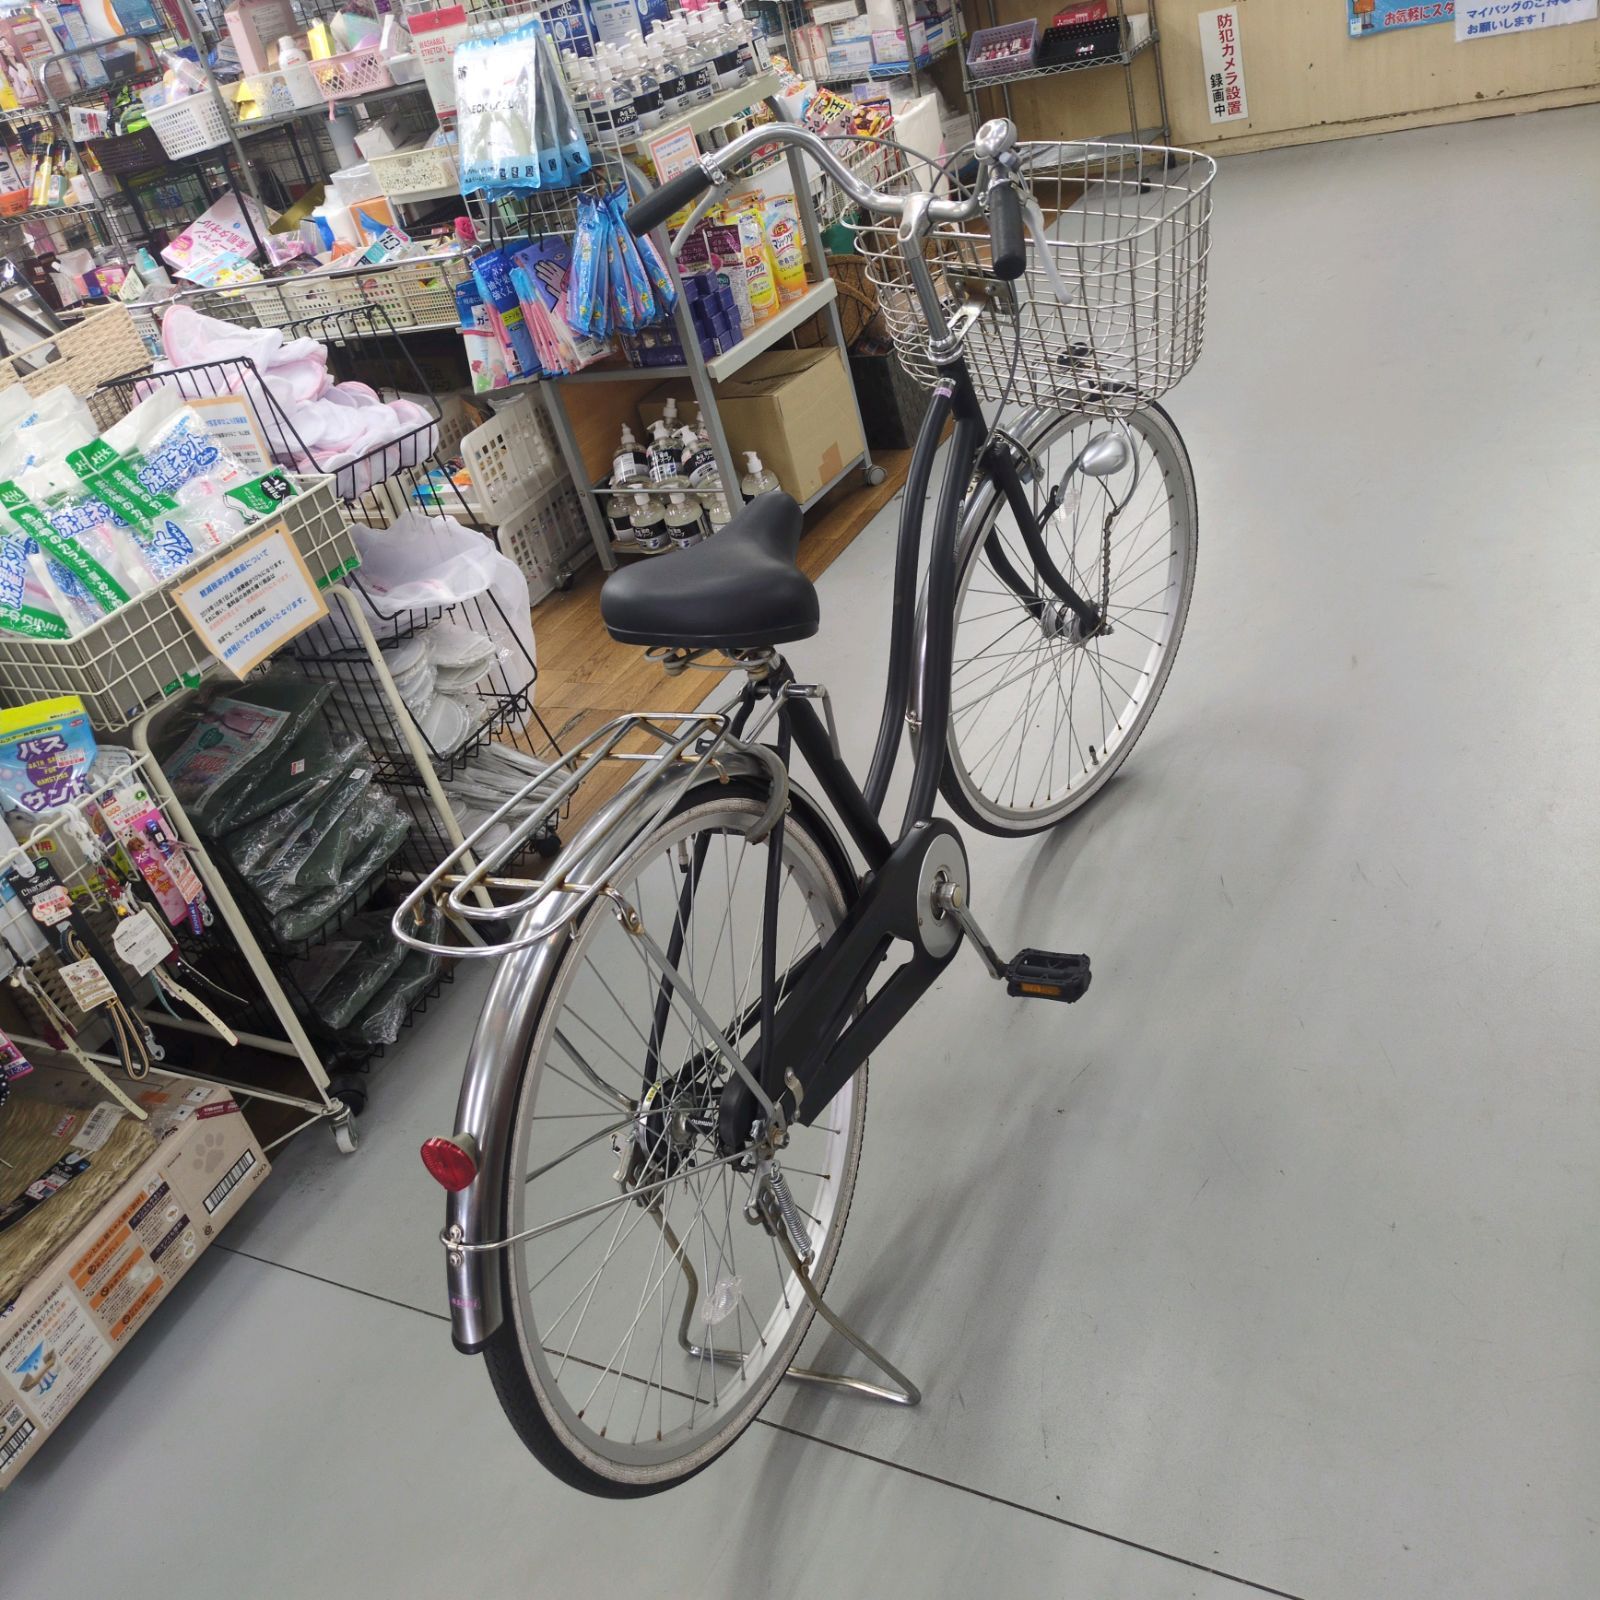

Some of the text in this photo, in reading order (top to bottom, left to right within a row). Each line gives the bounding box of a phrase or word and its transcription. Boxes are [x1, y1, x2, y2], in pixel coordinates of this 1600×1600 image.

[1216, 13, 1242, 116] 防犯カメラ設置
[1210, 73, 1226, 117] 録画中
[138, 433, 204, 495] 洗濯ネット
[20, 735, 66, 760] バス
